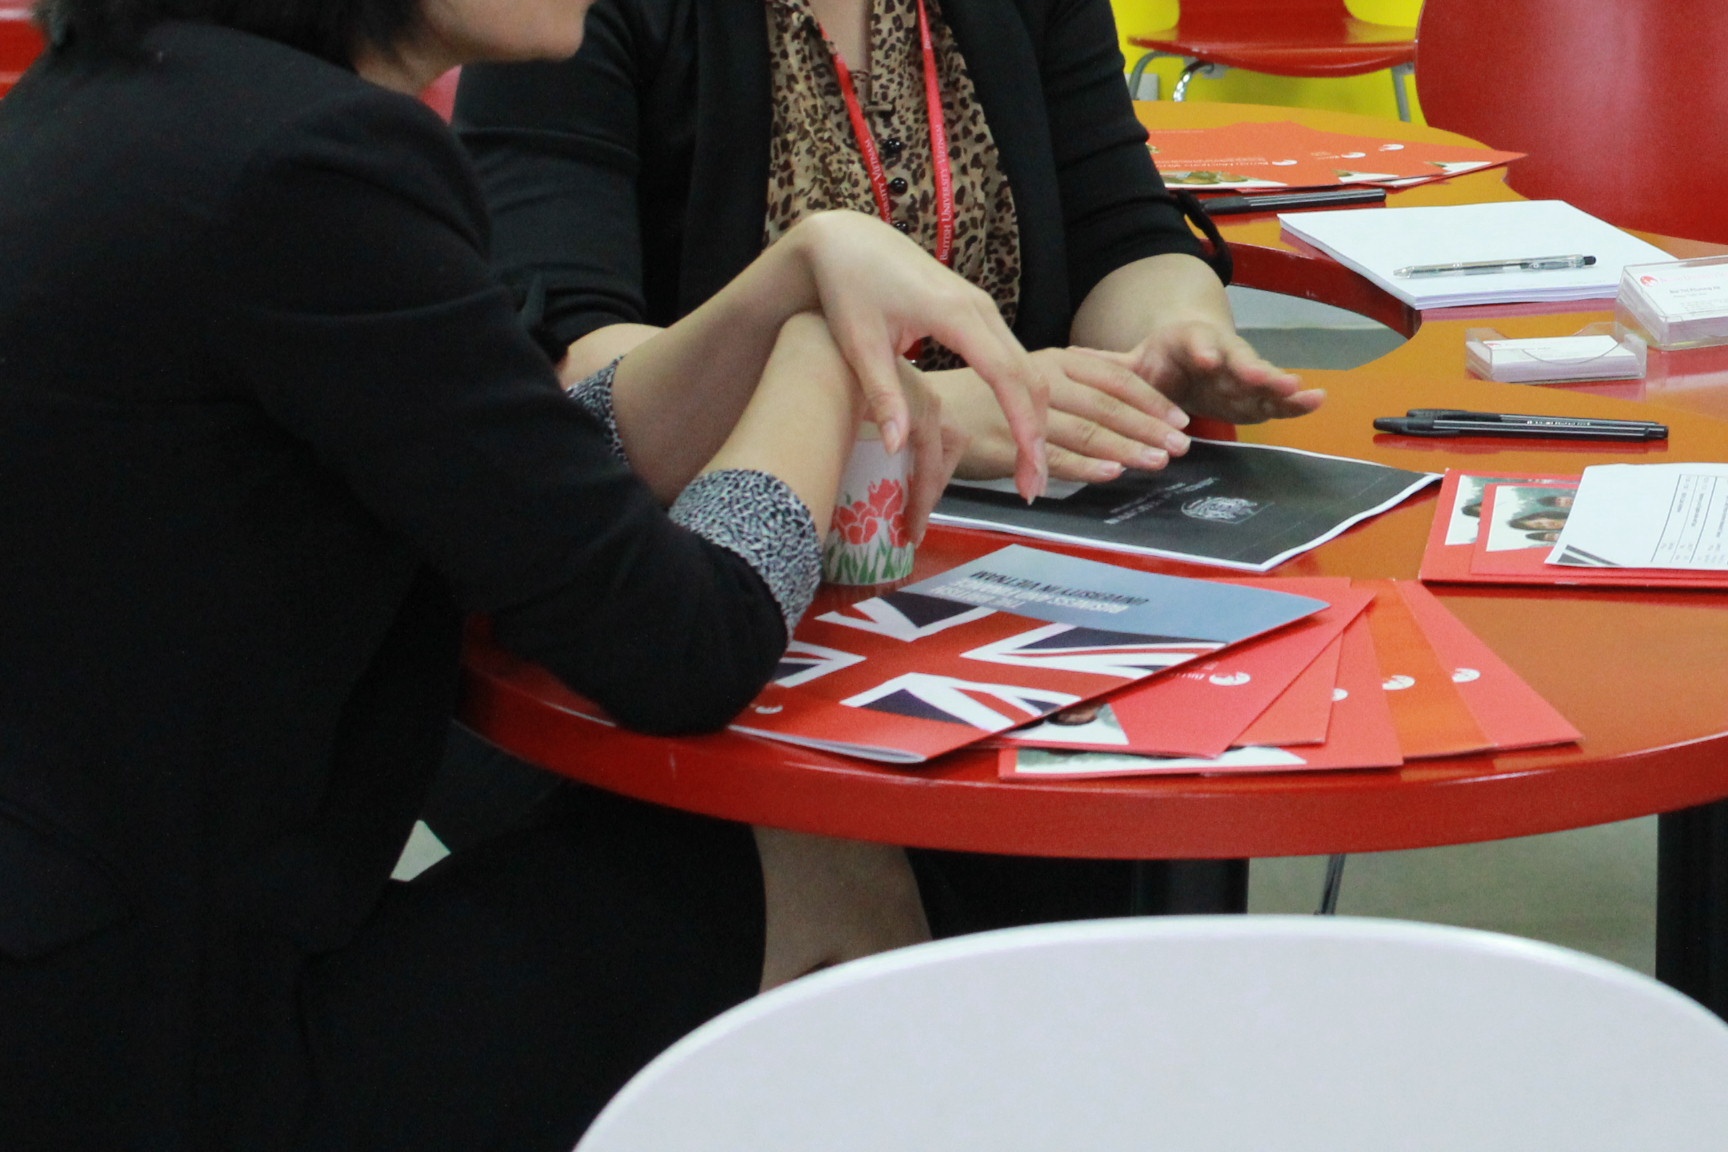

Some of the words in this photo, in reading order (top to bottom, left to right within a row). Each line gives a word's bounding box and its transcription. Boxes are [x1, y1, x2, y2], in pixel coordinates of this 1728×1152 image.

[864, 138, 883, 182] VIETNAM
[936, 123, 948, 165] VIETNAM
[939, 167, 953, 223] UNIVERSITY
[939, 224, 952, 261] BRITISH
[969, 570, 1042, 591] VIETNAM
